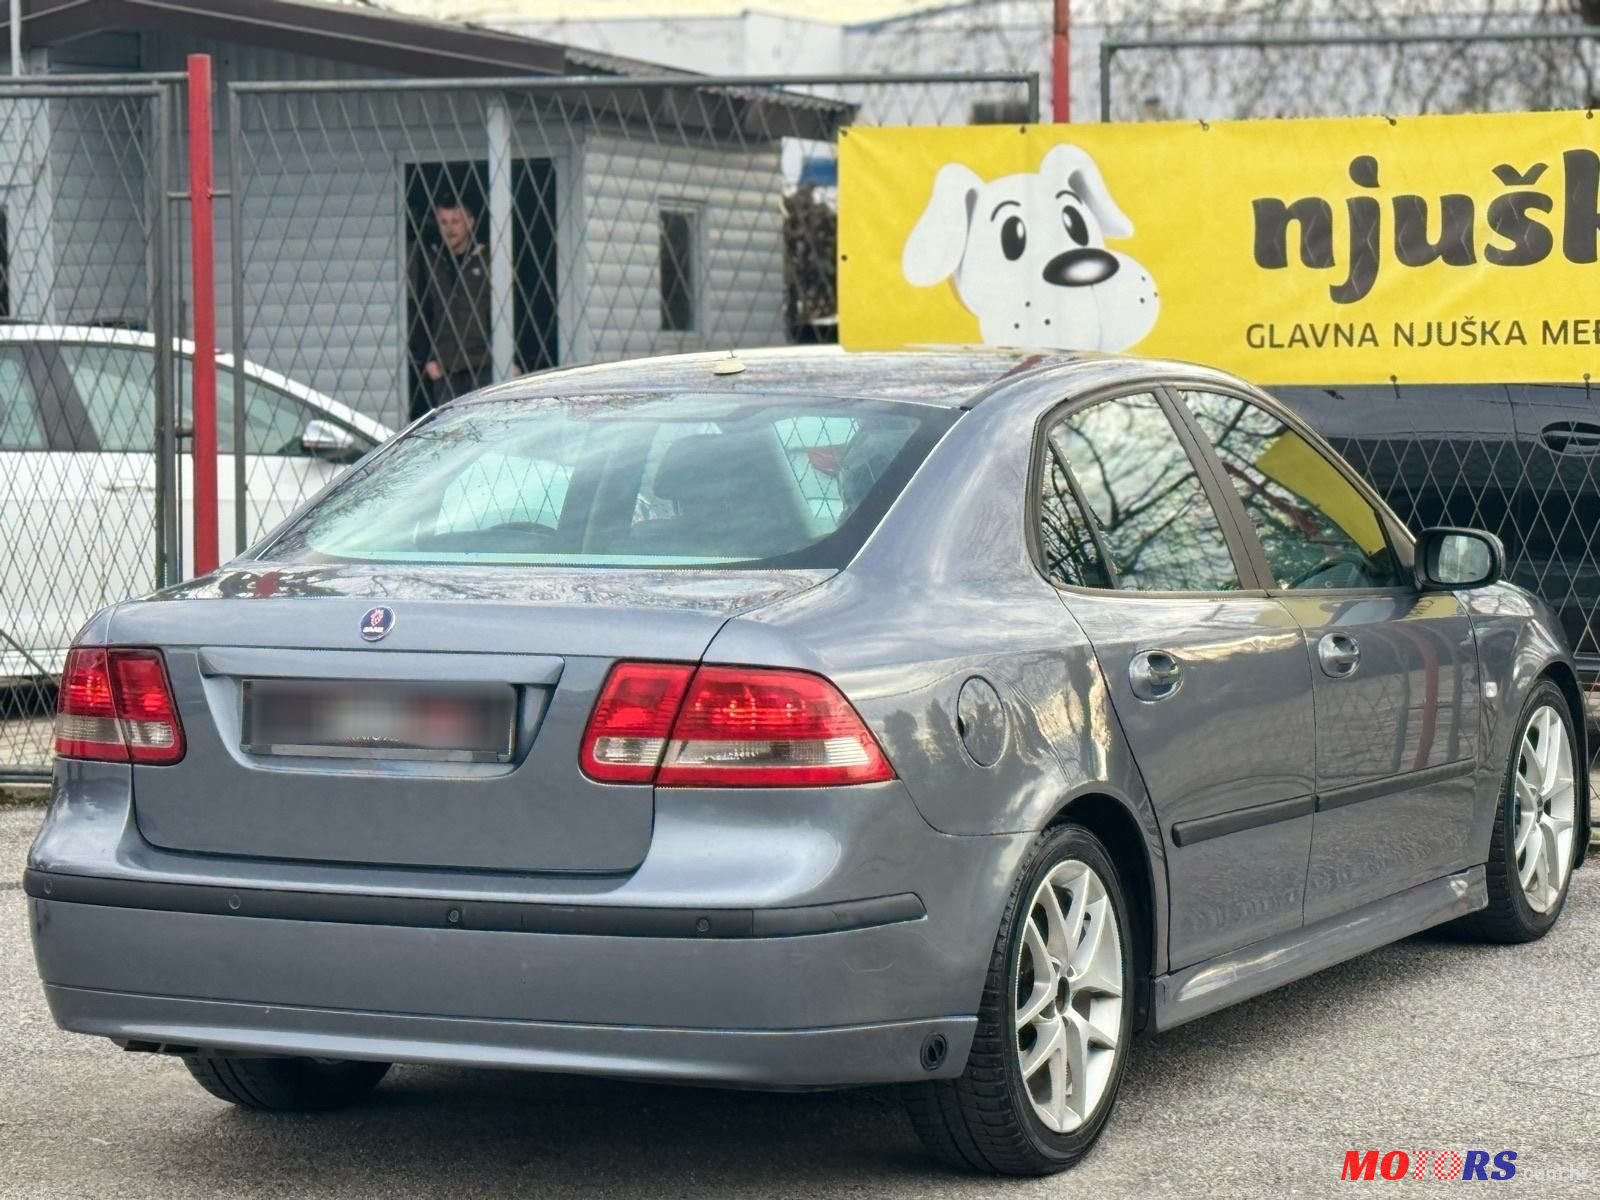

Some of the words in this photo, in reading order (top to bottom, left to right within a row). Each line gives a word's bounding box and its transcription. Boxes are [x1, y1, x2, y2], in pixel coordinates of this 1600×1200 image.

[1246, 323, 1379, 348] GLAVNA
[1394, 316, 1527, 347] NJUŠKA
[1542, 319, 1600, 345] ME
